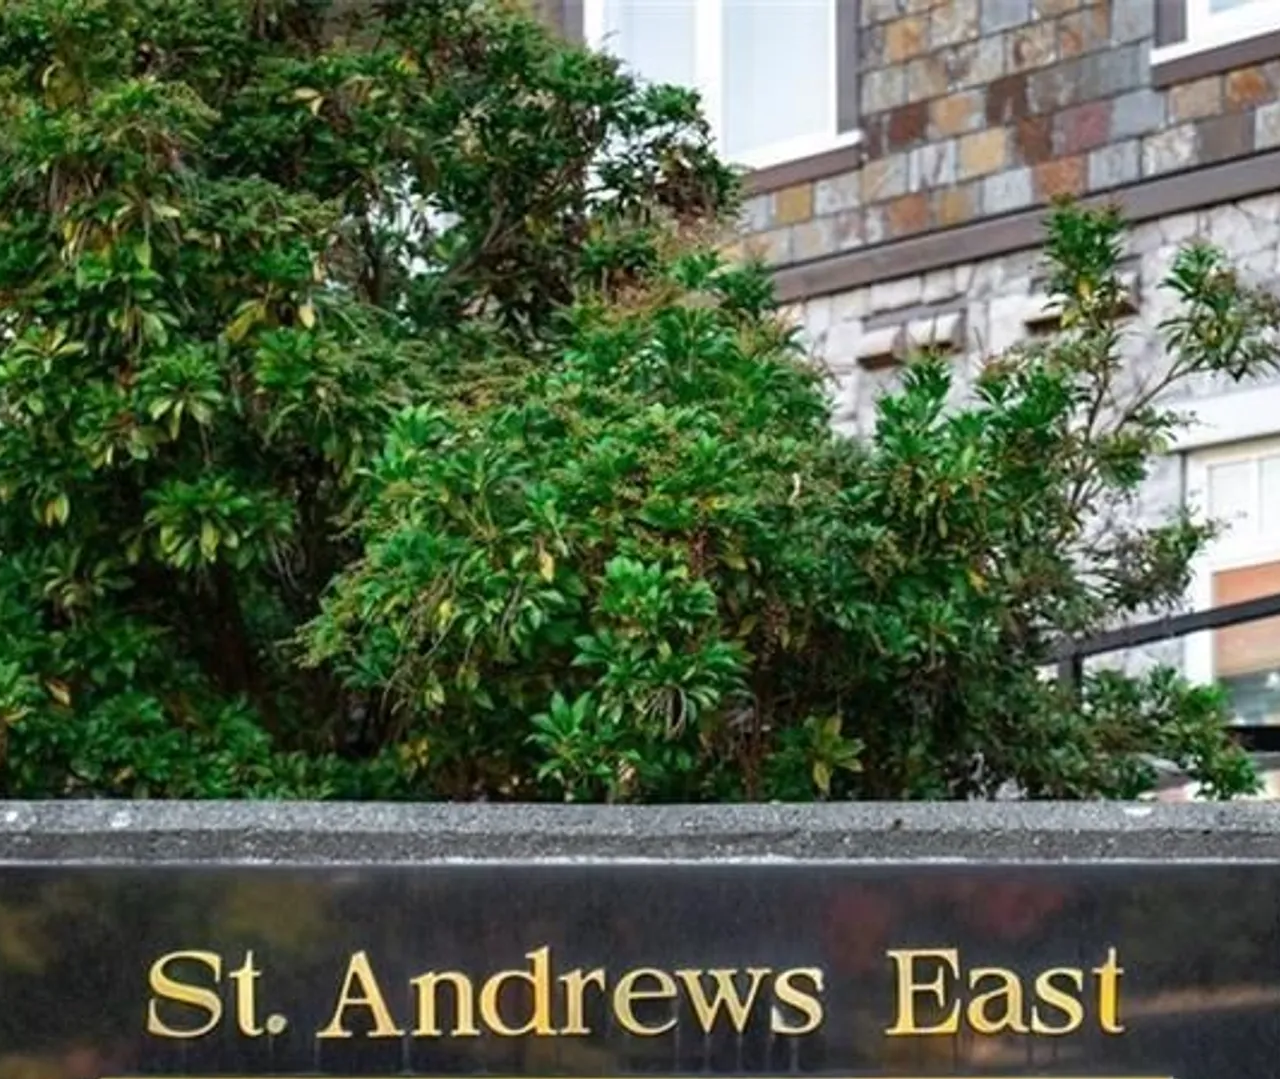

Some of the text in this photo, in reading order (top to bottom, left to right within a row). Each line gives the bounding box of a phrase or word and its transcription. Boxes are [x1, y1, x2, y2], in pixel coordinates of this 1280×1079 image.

[144, 945, 1128, 1040] St. Andrews East
